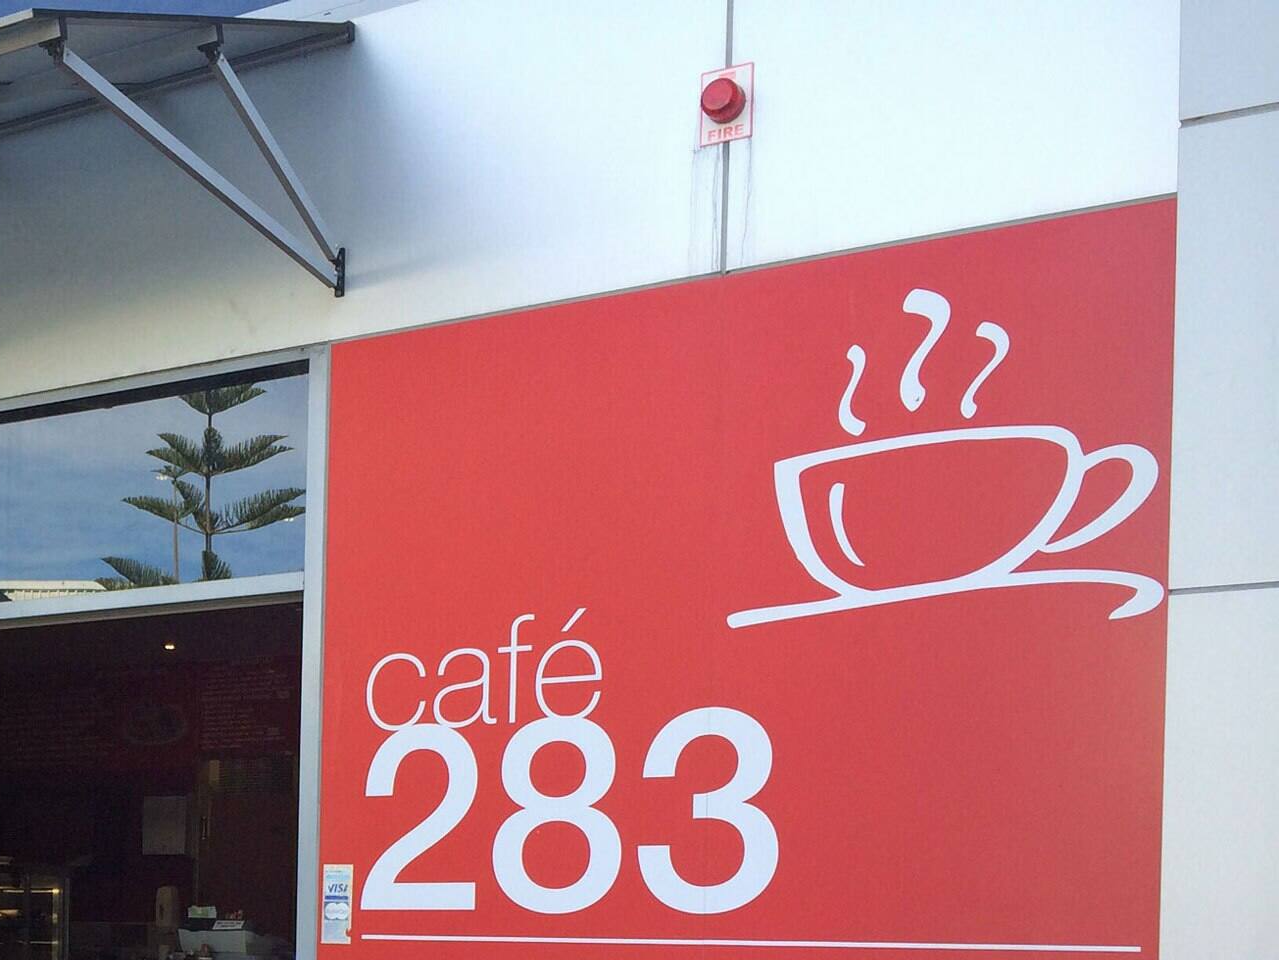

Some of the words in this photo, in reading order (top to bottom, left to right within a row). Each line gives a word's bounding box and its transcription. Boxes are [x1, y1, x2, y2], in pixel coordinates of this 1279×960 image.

[707, 124, 745, 142] FIRE
[365, 607, 604, 731] café
[360, 706, 779, 915] 283
